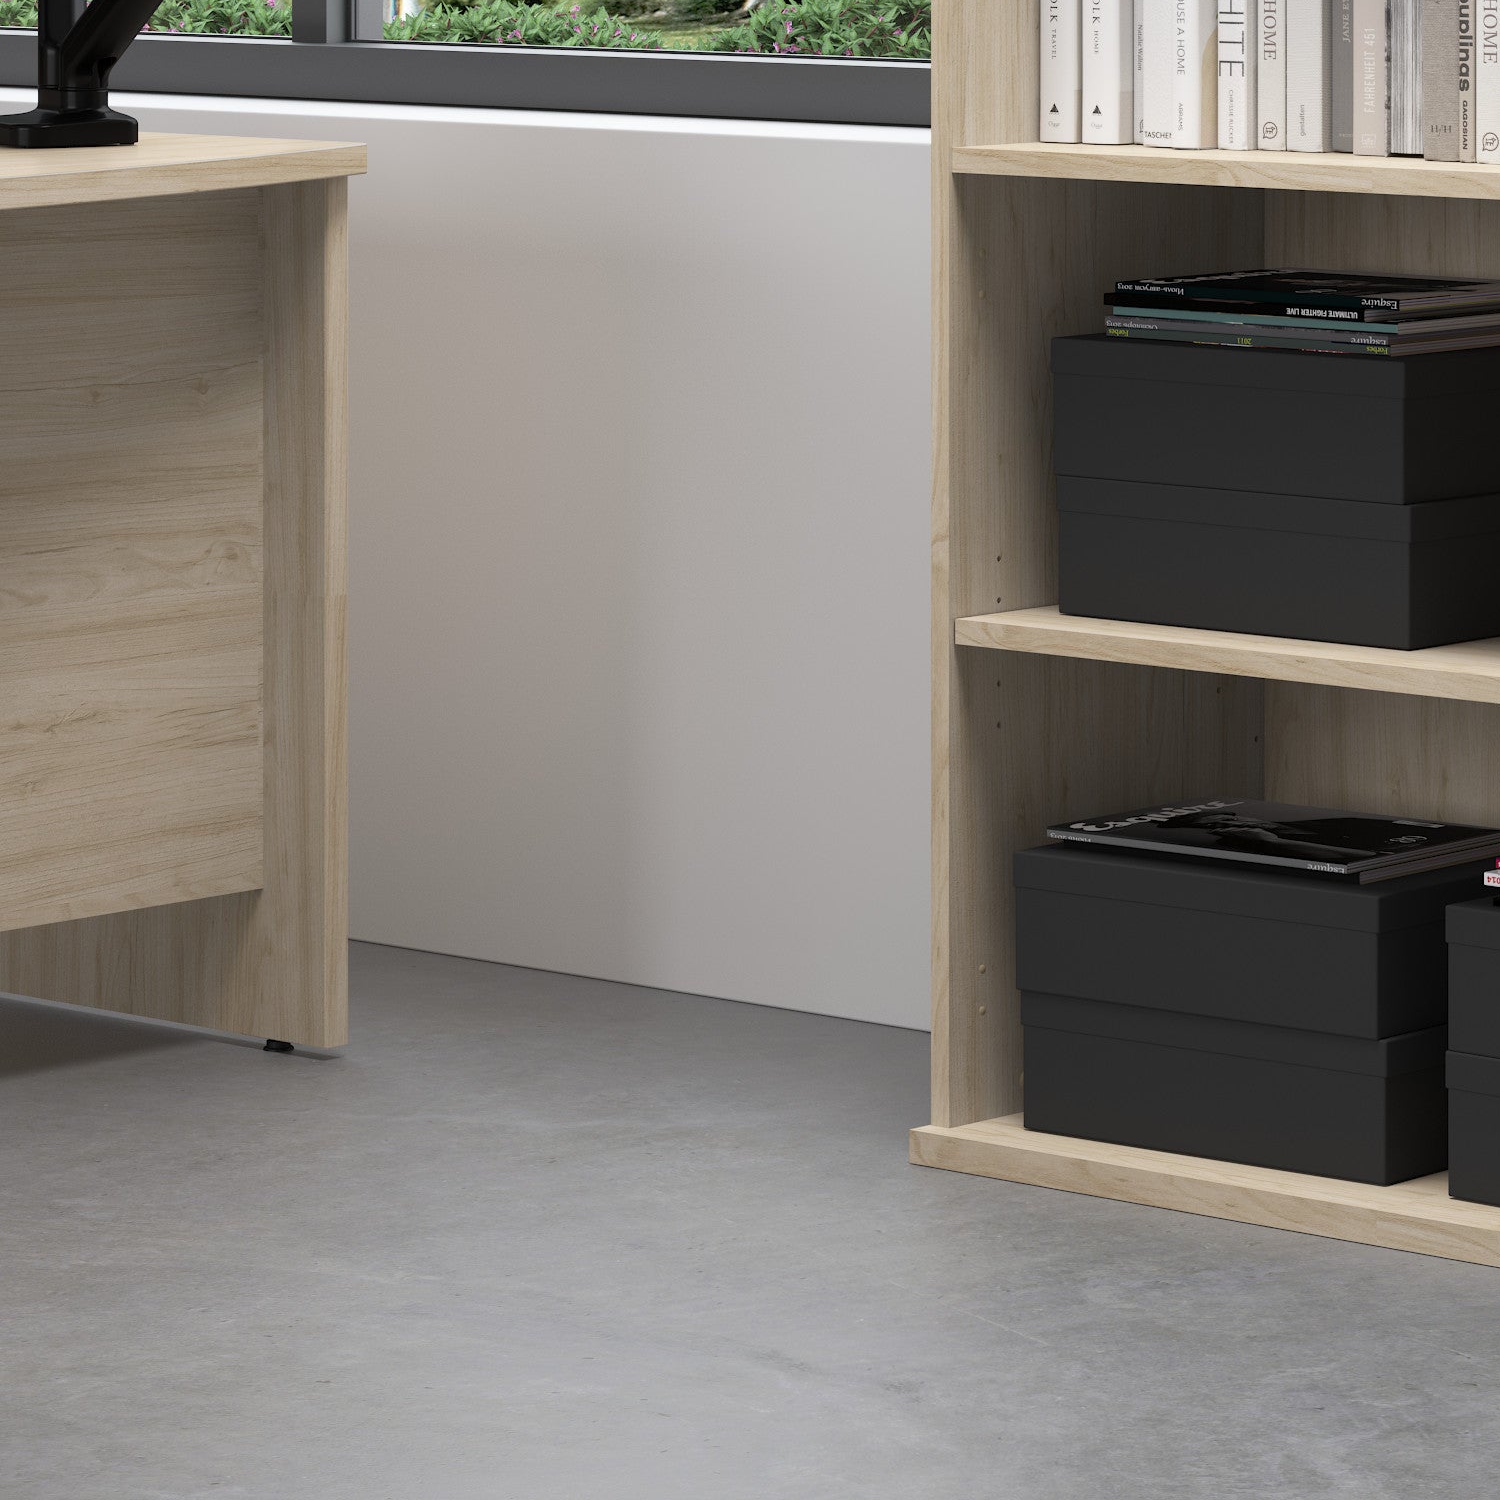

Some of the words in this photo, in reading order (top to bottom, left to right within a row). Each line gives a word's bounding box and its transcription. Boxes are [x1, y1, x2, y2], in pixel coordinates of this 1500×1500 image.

[1176, 27, 1186, 37] A
[1263, 0, 1278, 61] HOME
[1341, 13, 1351, 43] JANE
[1364, 27, 1374, 47] 451
[1176, 39, 1186, 75] HOME
[1364, 50, 1374, 114] FAHRENHEIT
[1461, 100, 1469, 151] GAGOSIAN
[1285, 307, 1301, 316] LIVE
[1361, 298, 1398, 310] Esquire
[1301, 308, 1328, 318] FIGHTER
[1328, 310, 1359, 320] ULTIMATE
[1108, 329, 1129, 338] Forbes
[1236, 337, 1252, 345] 2011
[1366, 345, 1389, 355] Forbes
